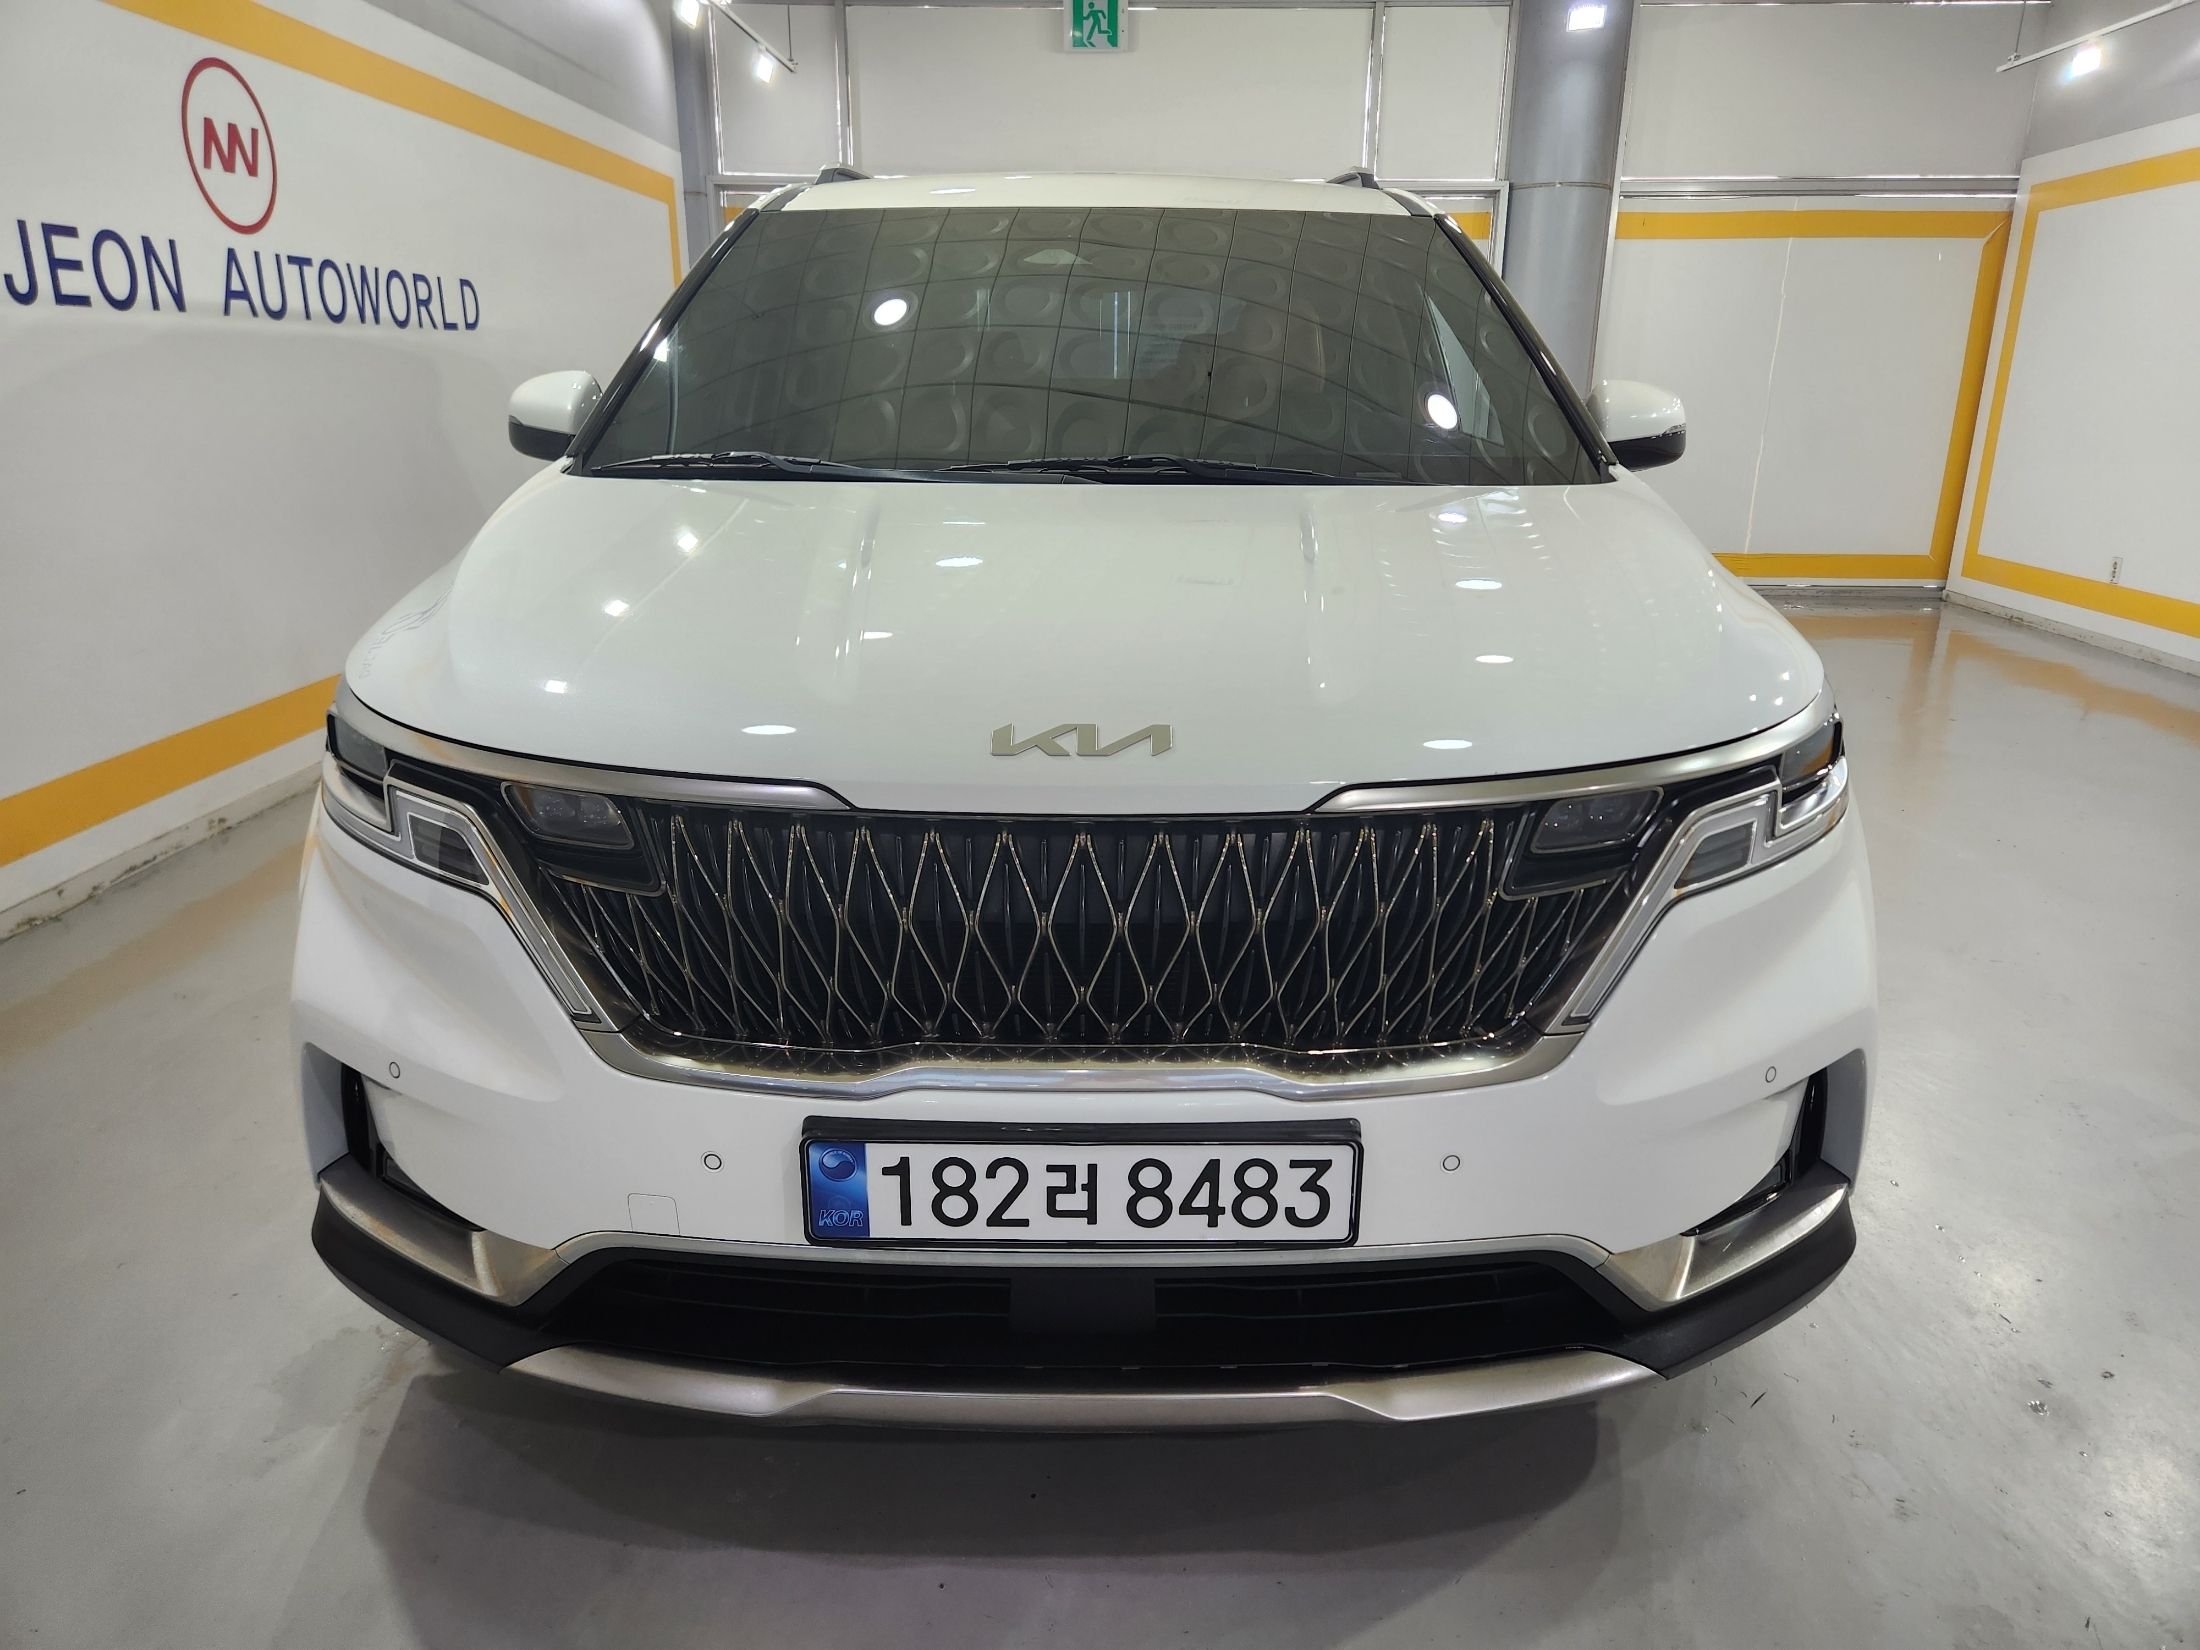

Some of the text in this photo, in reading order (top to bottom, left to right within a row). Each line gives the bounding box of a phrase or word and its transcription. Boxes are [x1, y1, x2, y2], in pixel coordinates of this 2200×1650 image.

[3, 219, 481, 331] JEON AUTOWORLD
[818, 1209, 864, 1227] KOR
[881, 1156, 1333, 1229] 182러 8483
